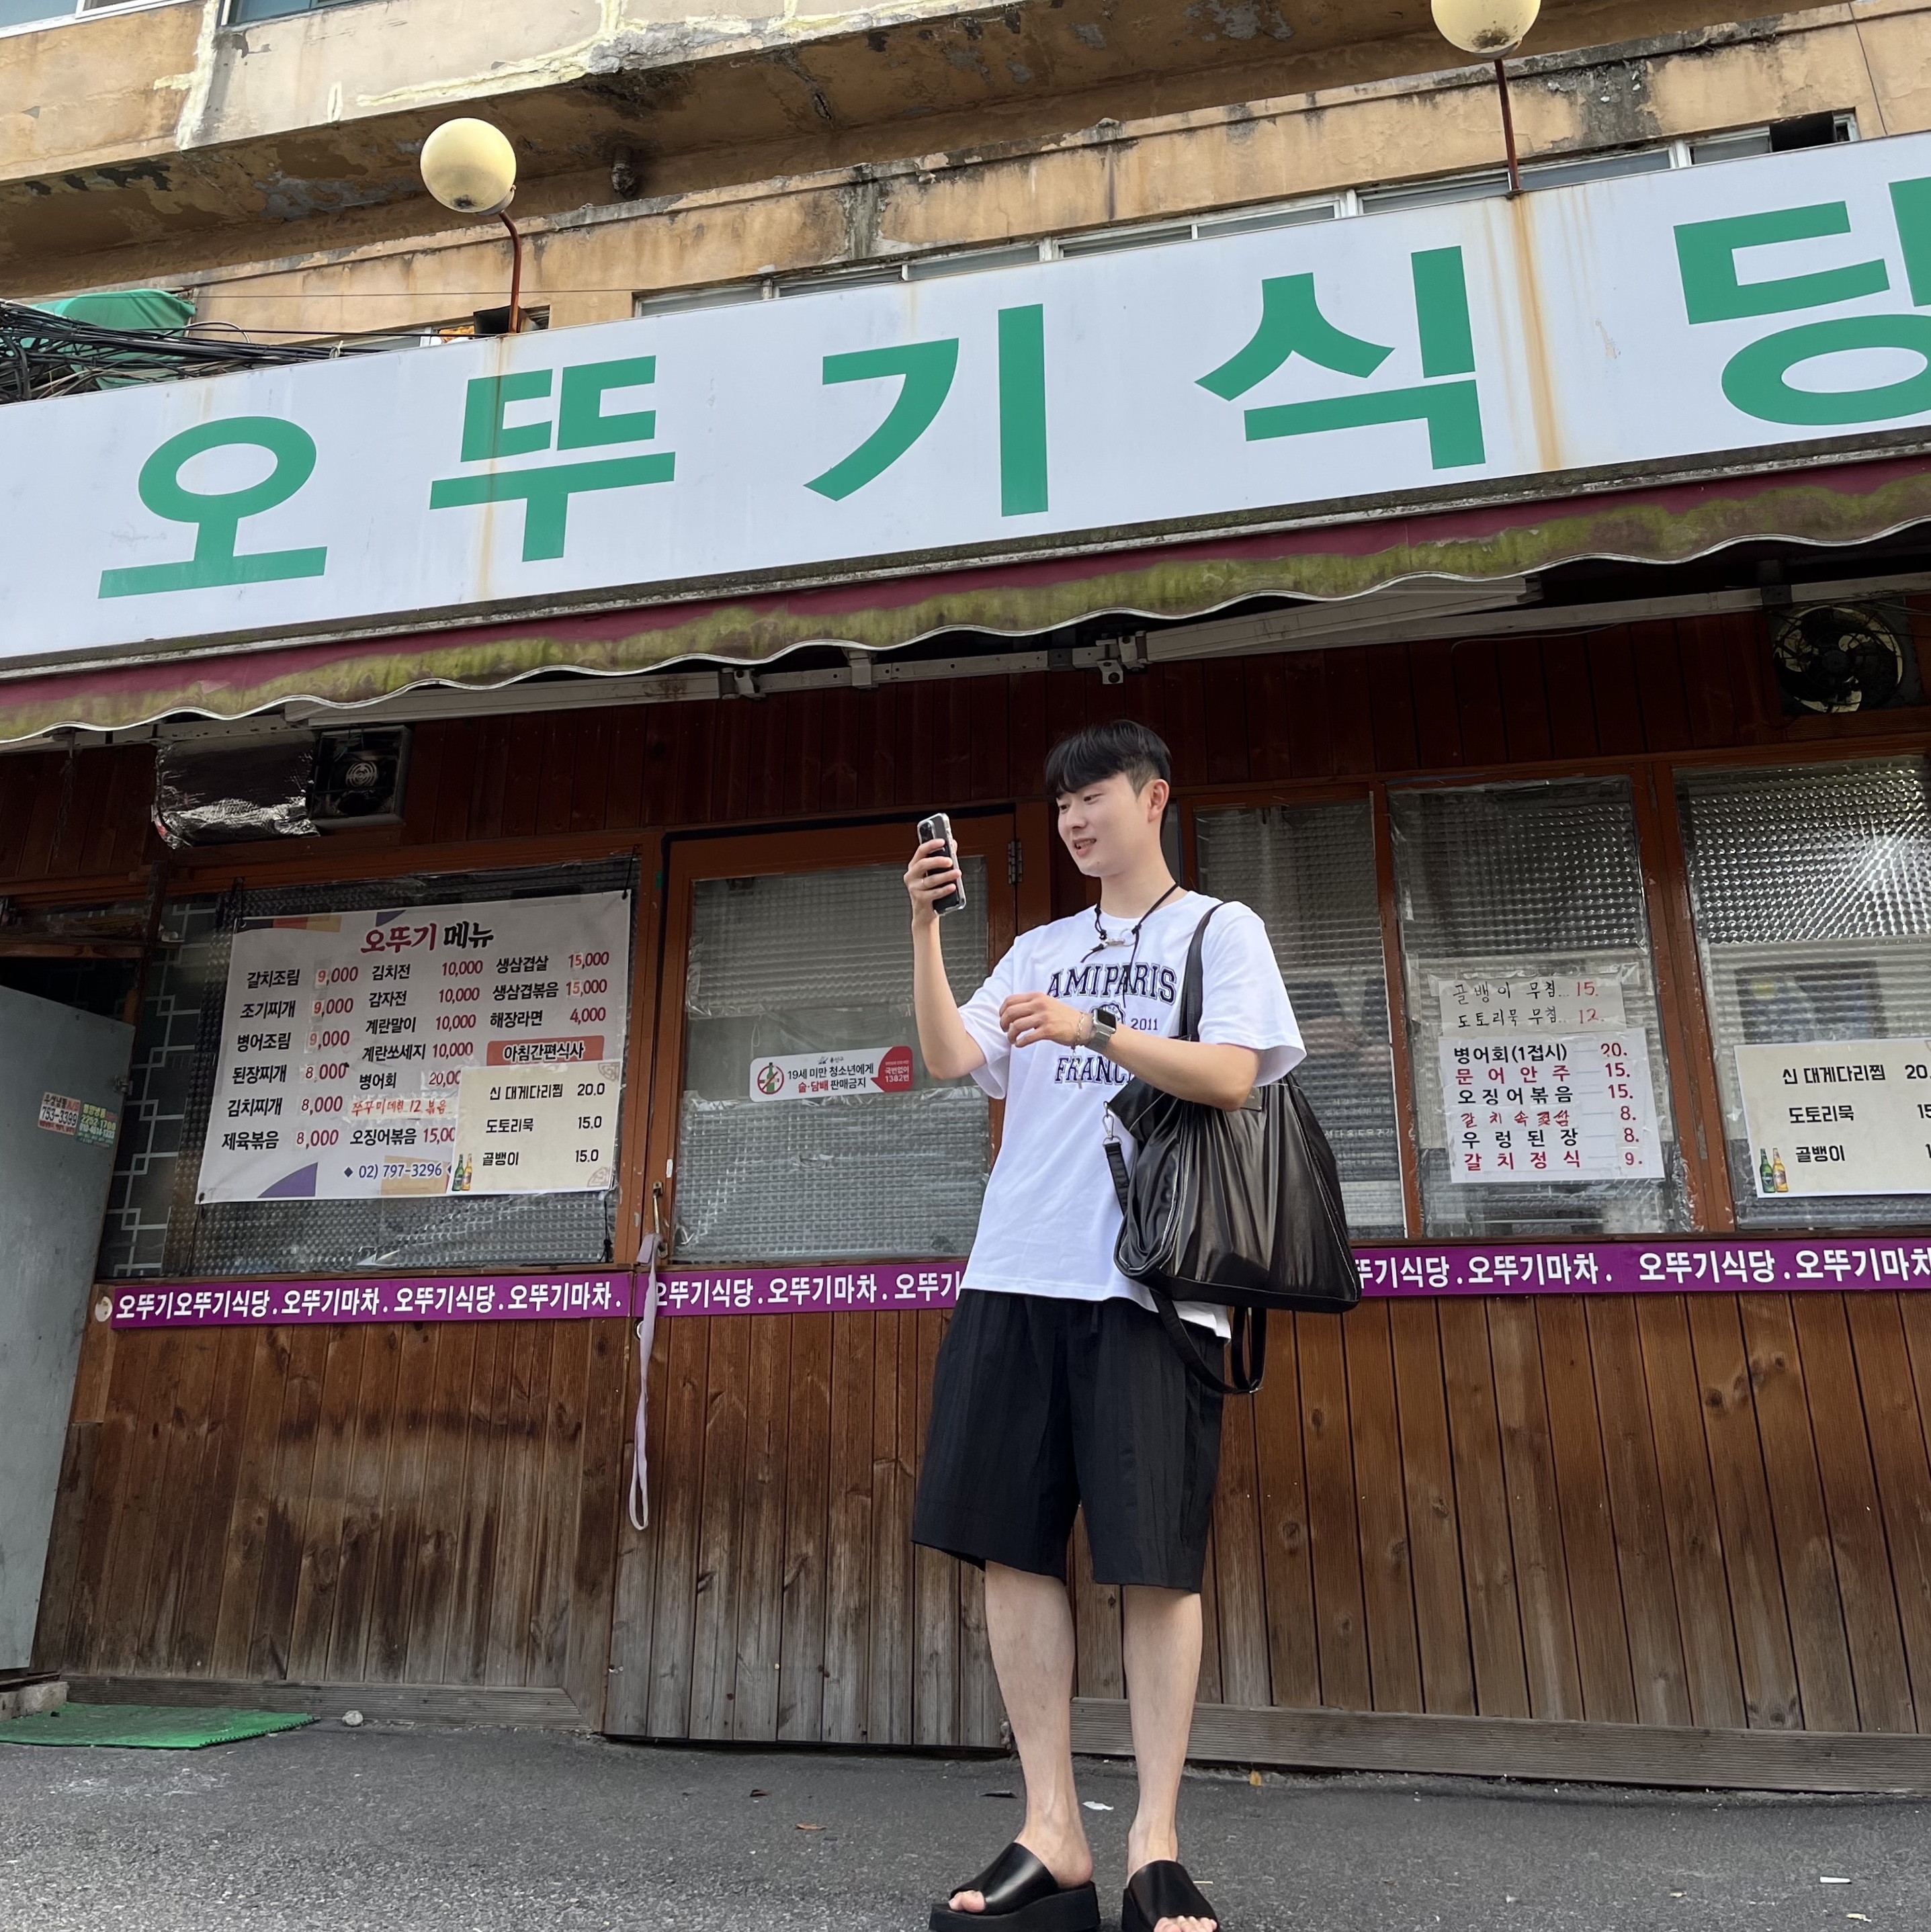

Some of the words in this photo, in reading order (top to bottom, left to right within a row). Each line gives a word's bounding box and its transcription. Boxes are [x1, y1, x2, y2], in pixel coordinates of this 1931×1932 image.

[360, 922, 437, 954] 오뚜기
[443, 921, 494, 949] 메뉴
[372, 963, 411, 981] 김치전
[441, 961, 483, 977] 10,000
[496, 955, 548, 974] 생삼겹살
[568, 952, 609, 969] 15,000
[247, 969, 300, 989] 갈치조림
[317, 966, 359, 986] 9,000
[369, 990, 407, 1008] 감자전
[439, 987, 480, 1004] 10,000
[492, 981, 559, 1001] 생삼겹볶음
[566, 979, 607, 997] 15,000
[1453, 981, 1510, 1005] 골뱅이
[240, 1000, 296, 1018] 조기찌개
[314, 998, 354, 1017] 9,000
[490, 1010, 543, 1028] 해장라면
[570, 1007, 606, 1025] 4,000
[366, 1016, 417, 1035] 계란말이
[436, 1014, 476, 1032] 10,000
[1131, 1018, 1158, 1030] 2011
[1457, 1009, 1518, 1028] 도토리묵
[237, 1032, 292, 1052] 병어조림
[309, 1030, 350, 1050] 9,000
[361, 1043, 426, 1062] 계란쏘세지
[433, 1042, 473, 1059] 10,000
[504, 1042, 584, 1061] 아침간편식사
[1453, 1043, 1567, 1064] 병어회(1접시)
[232, 1064, 287, 1084] 된장찌개
[305, 1063, 347, 1083] 8,000
[359, 1072, 396, 1090] 병어회
[429, 1070, 461, 1088] 20,00
[787, 1069, 807, 1080] 19세
[809, 1067, 827, 1078] 미만
[828, 1063, 873, 1078] 청소년에게
[884, 1065, 910, 1075] 국번없이
[1054, 1054, 1132, 1086] FRANC
[1803, 1064, 1886, 1084] 대게다리찜
[505, 1083, 564, 1100] 대게다리찜
[577, 1083, 605, 1096] 20.0
[830, 1077, 866, 1090] 판매금지
[227, 1097, 283, 1117] 김치찌개
[301, 1096, 343, 1116] 8,000
[409, 1100, 422, 1112] 12
[1789, 1105, 1854, 1124] 도토리묵
[41, 1106, 78, 1127] 753-3399
[486, 1118, 533, 1133] 도토리묵
[578, 1116, 602, 1129] 15.0
[221, 1130, 280, 1151] 제육볶음
[296, 1129, 339, 1150] 8,000
[349, 1128, 417, 1145] 오징어볶음
[423, 1127, 455, 1145] 15,00
[482, 1151, 519, 1166] 골뱅이
[575, 1149, 599, 1163] 15.0
[1796, 1145, 1846, 1163] 골뱅이
[359, 1163, 378, 1180] 02)
[383, 1163, 442, 1178] 797-3296
